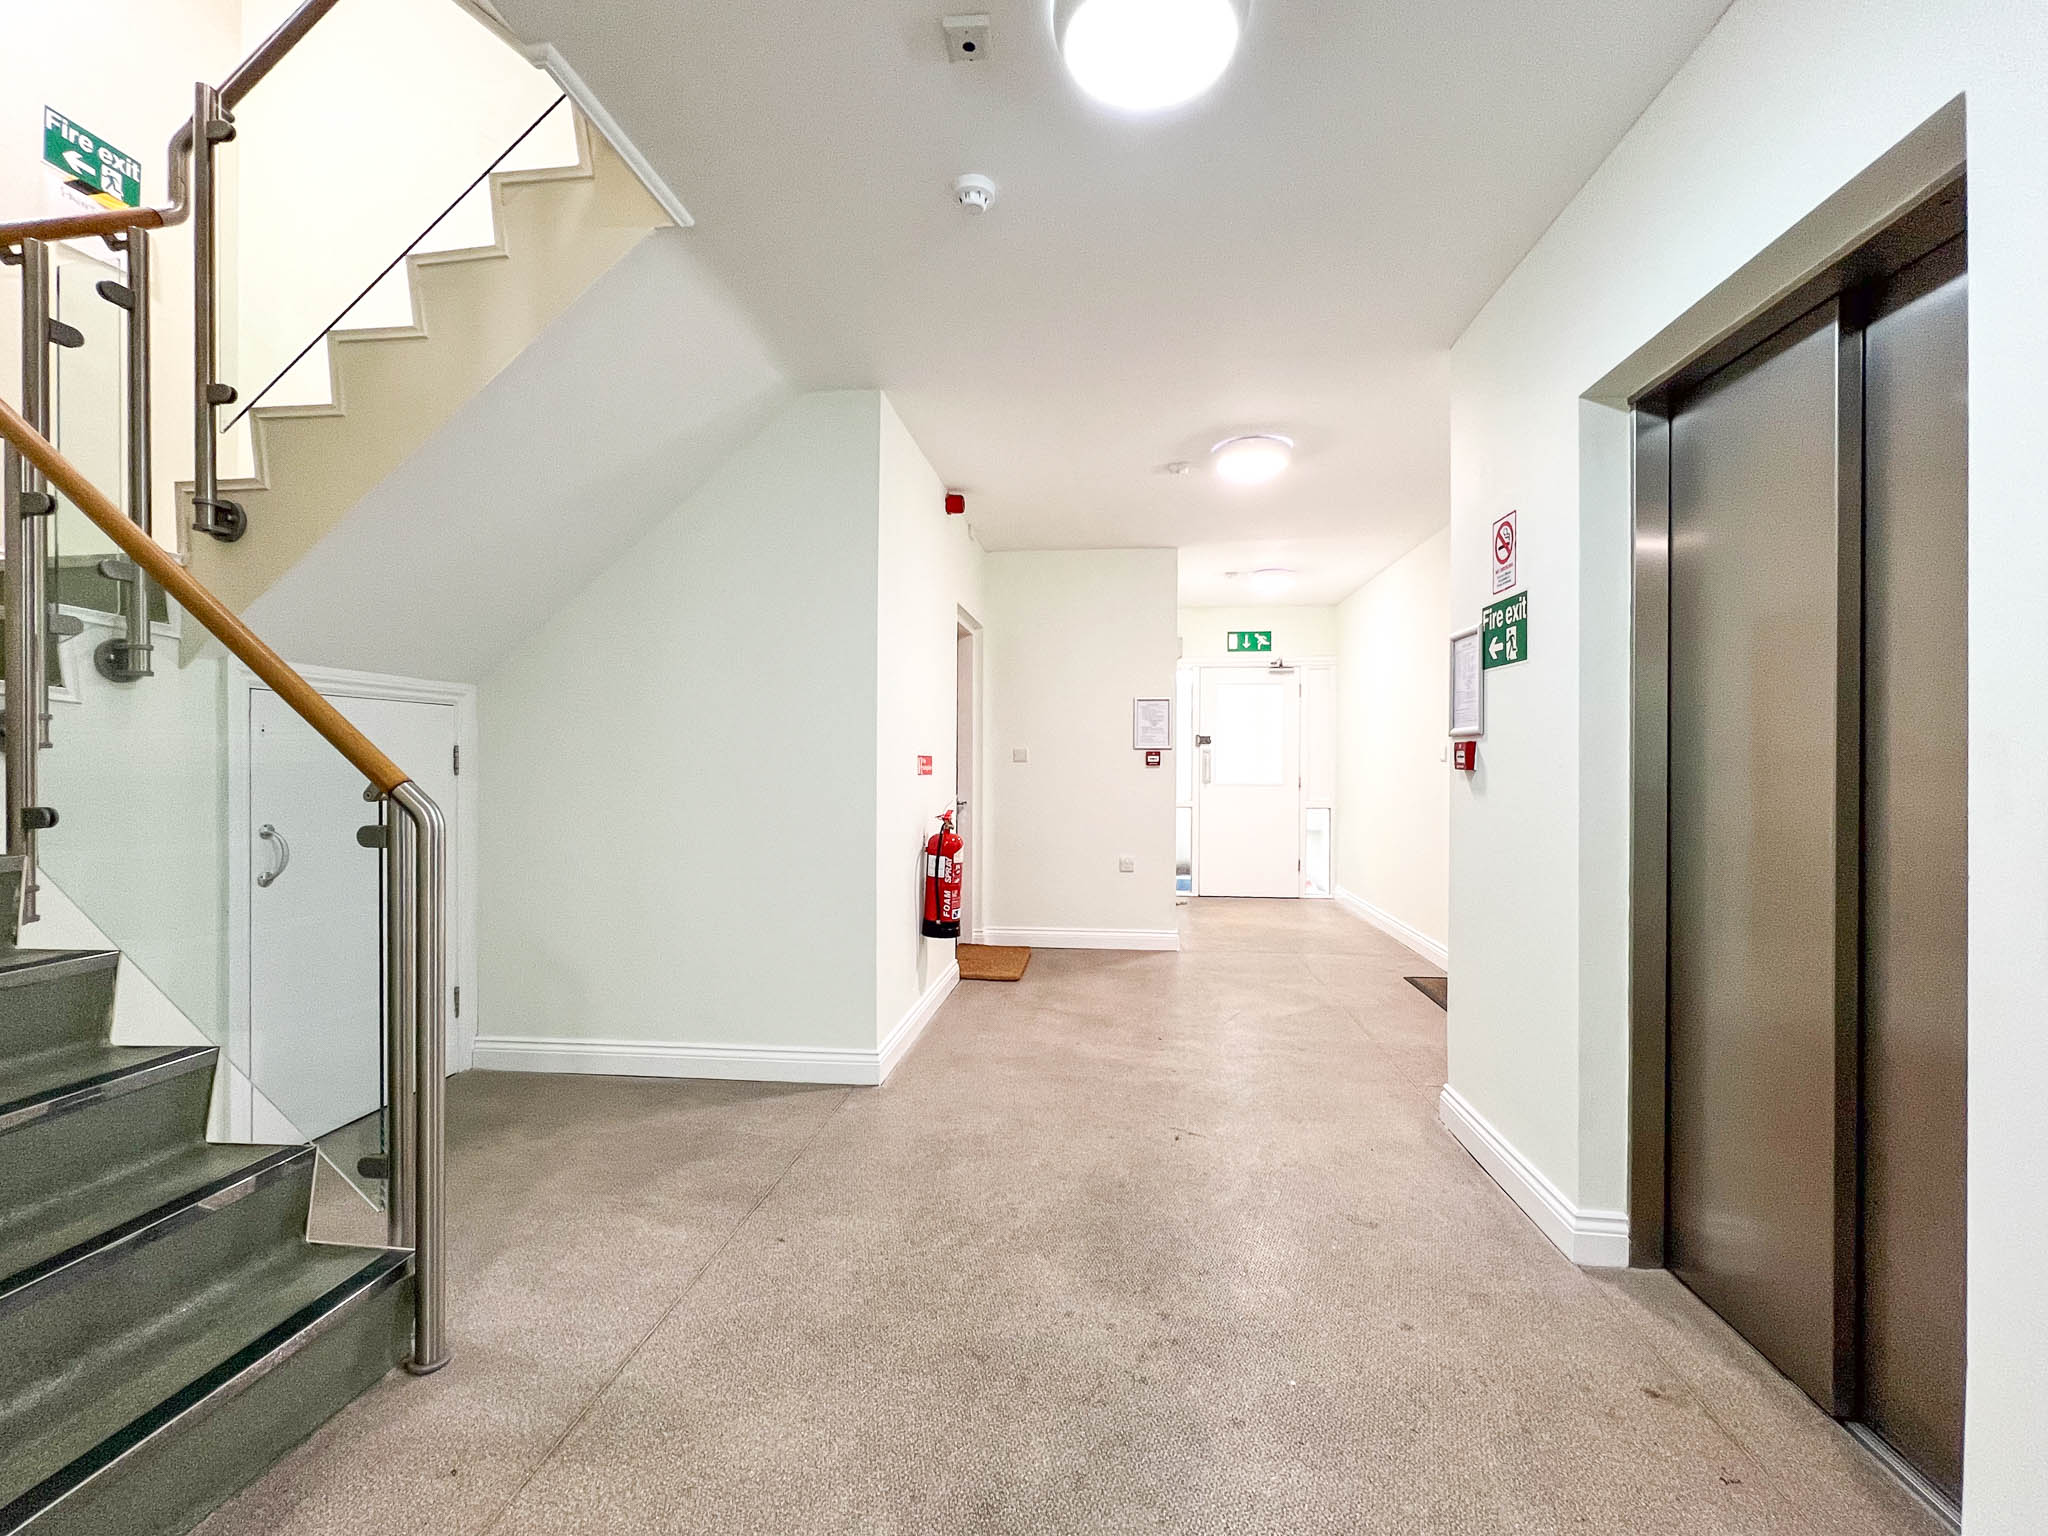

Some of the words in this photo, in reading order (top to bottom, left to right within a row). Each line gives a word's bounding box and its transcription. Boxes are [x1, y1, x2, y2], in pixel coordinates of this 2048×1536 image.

[46, 108, 94, 153] Fire
[98, 146, 140, 182] exit
[1483, 608, 1503, 632] Fire
[1506, 596, 1527, 625] exit
[944, 856, 953, 883] SPRAY
[943, 890, 952, 918] FOAM
